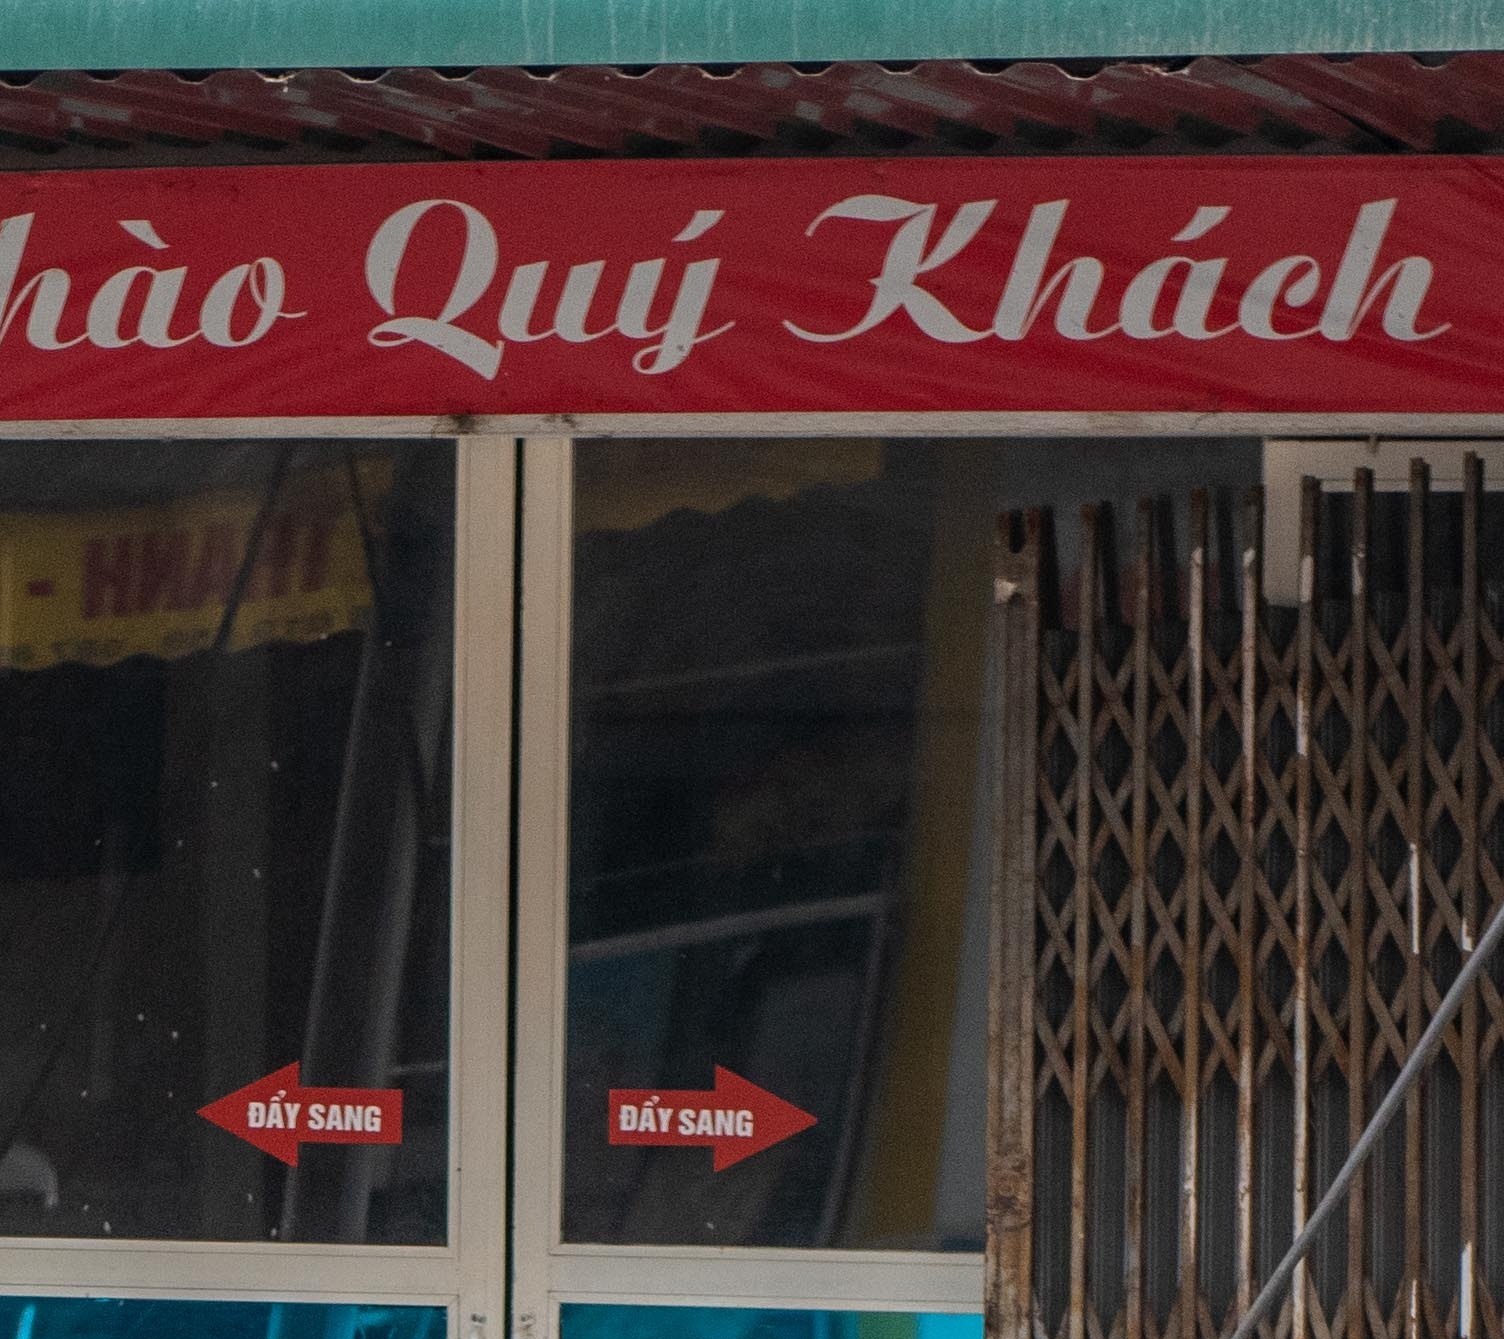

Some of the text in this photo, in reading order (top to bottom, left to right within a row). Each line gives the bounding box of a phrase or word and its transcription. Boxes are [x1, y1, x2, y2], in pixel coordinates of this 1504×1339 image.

[365, 197, 736, 381] Quý
[783, 194, 1452, 344] Khách
[247, 1089, 382, 1133] ĐẨY SANG
[619, 1095, 754, 1138] ĐẨY SANG
